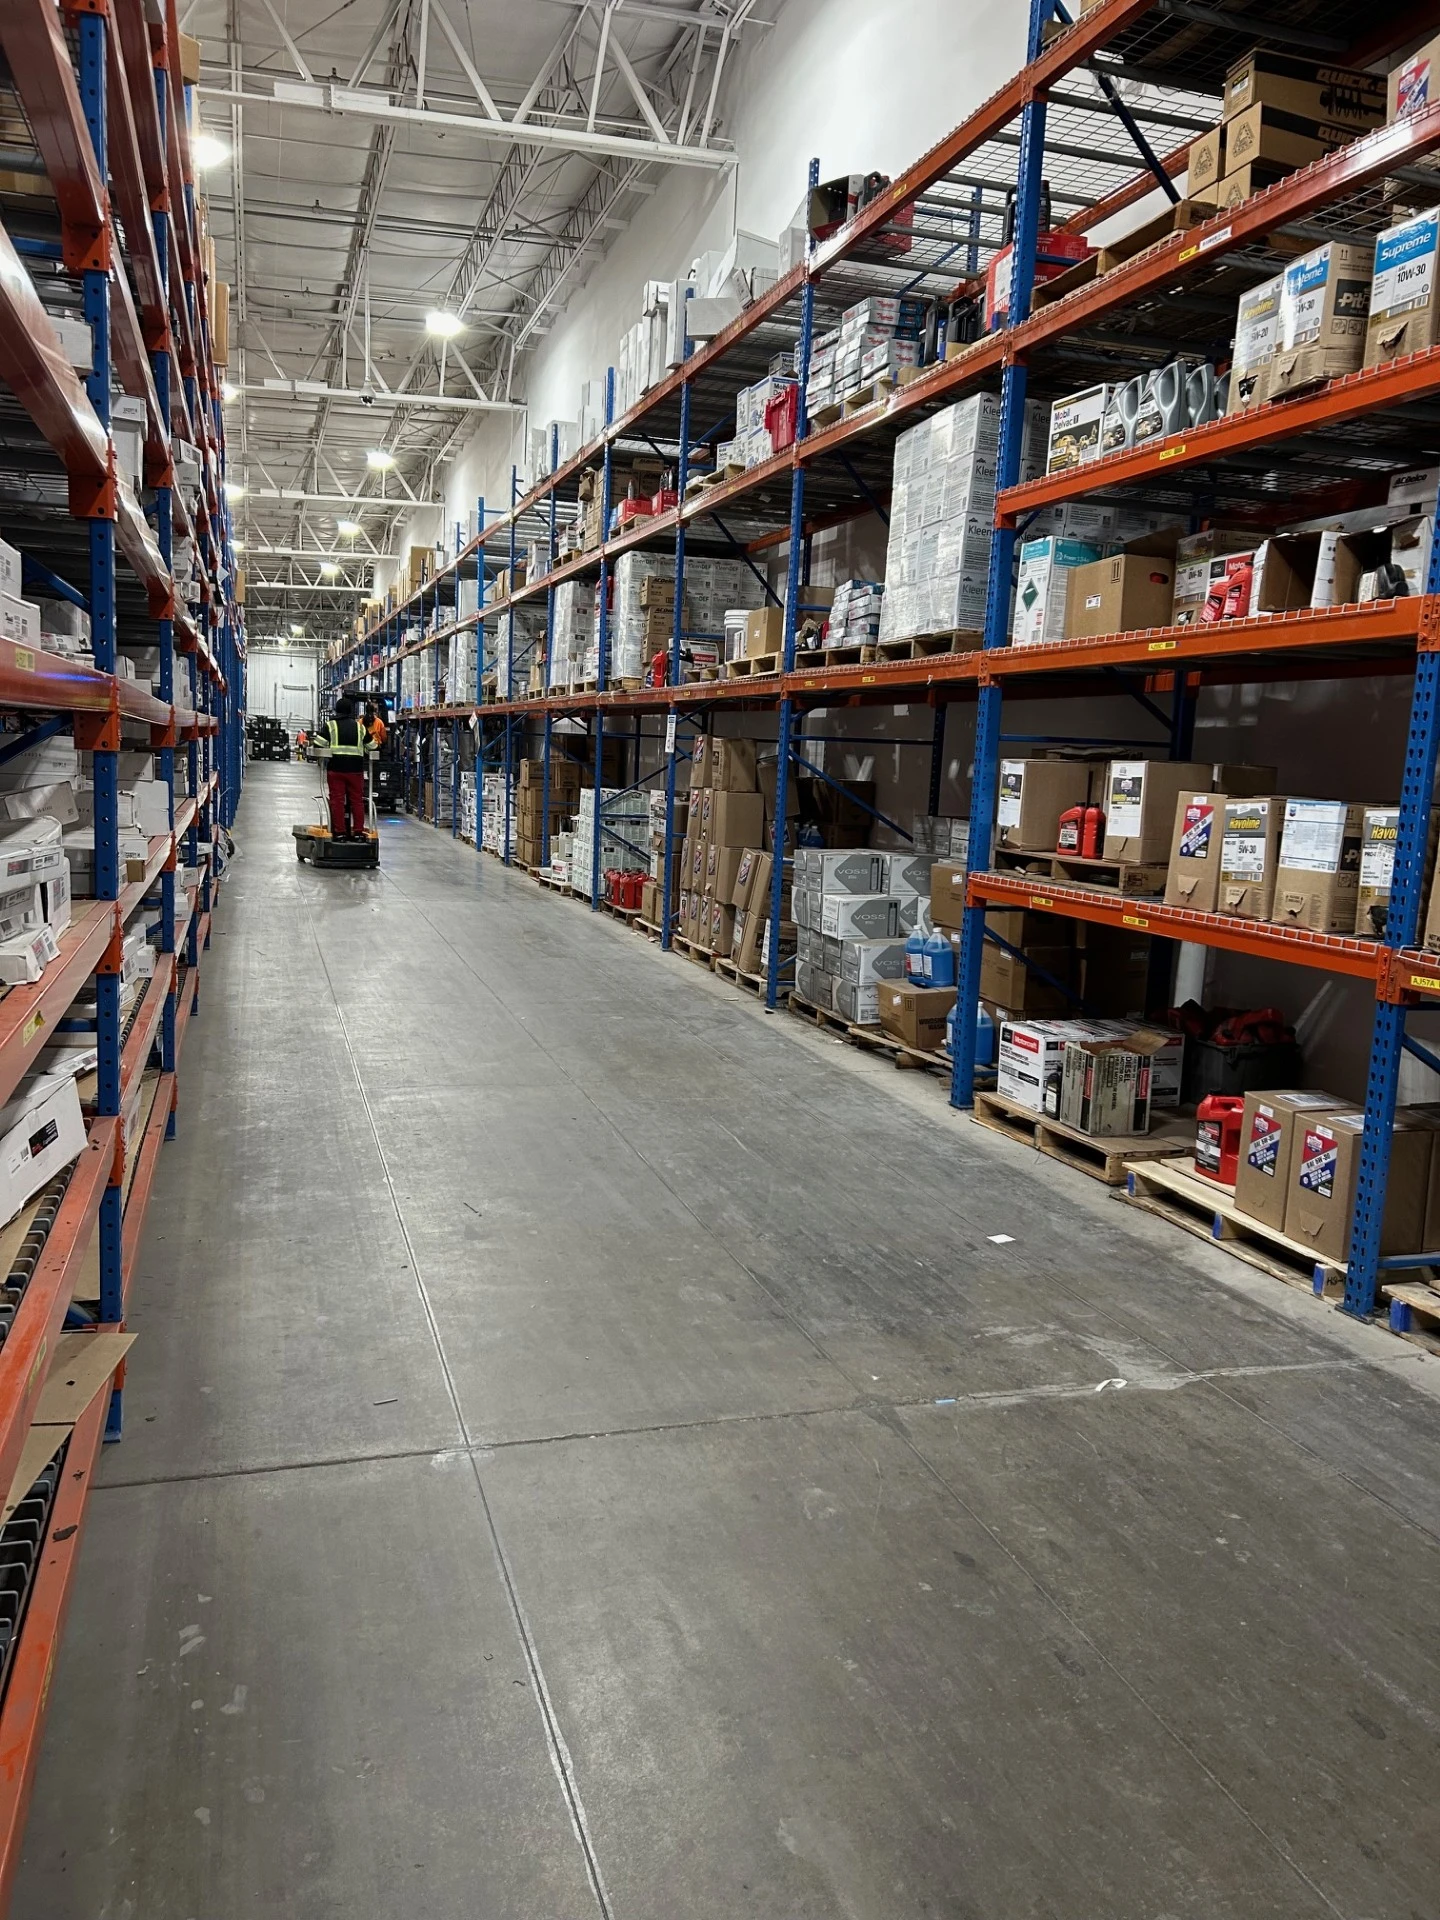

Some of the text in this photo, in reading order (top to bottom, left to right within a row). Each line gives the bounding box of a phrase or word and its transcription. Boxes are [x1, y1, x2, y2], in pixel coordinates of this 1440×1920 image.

[1380, 232, 1431, 261] Supreme
[1397, 263, 1426, 283] 10W-30
[983, 405, 1000, 417] Klee
[1054, 408, 1070, 420] Mobil
[1032, 412, 1050, 424] Klee
[1054, 417, 1073, 431] Delvac
[968, 525, 991, 537] Kleen
[1229, 816, 1261, 829] Havoline
[1238, 845, 1256, 854] 5W-30
[1413, 978, 1435, 987] AJ57A
[1124, 1056, 1132, 1083] DIESEL
